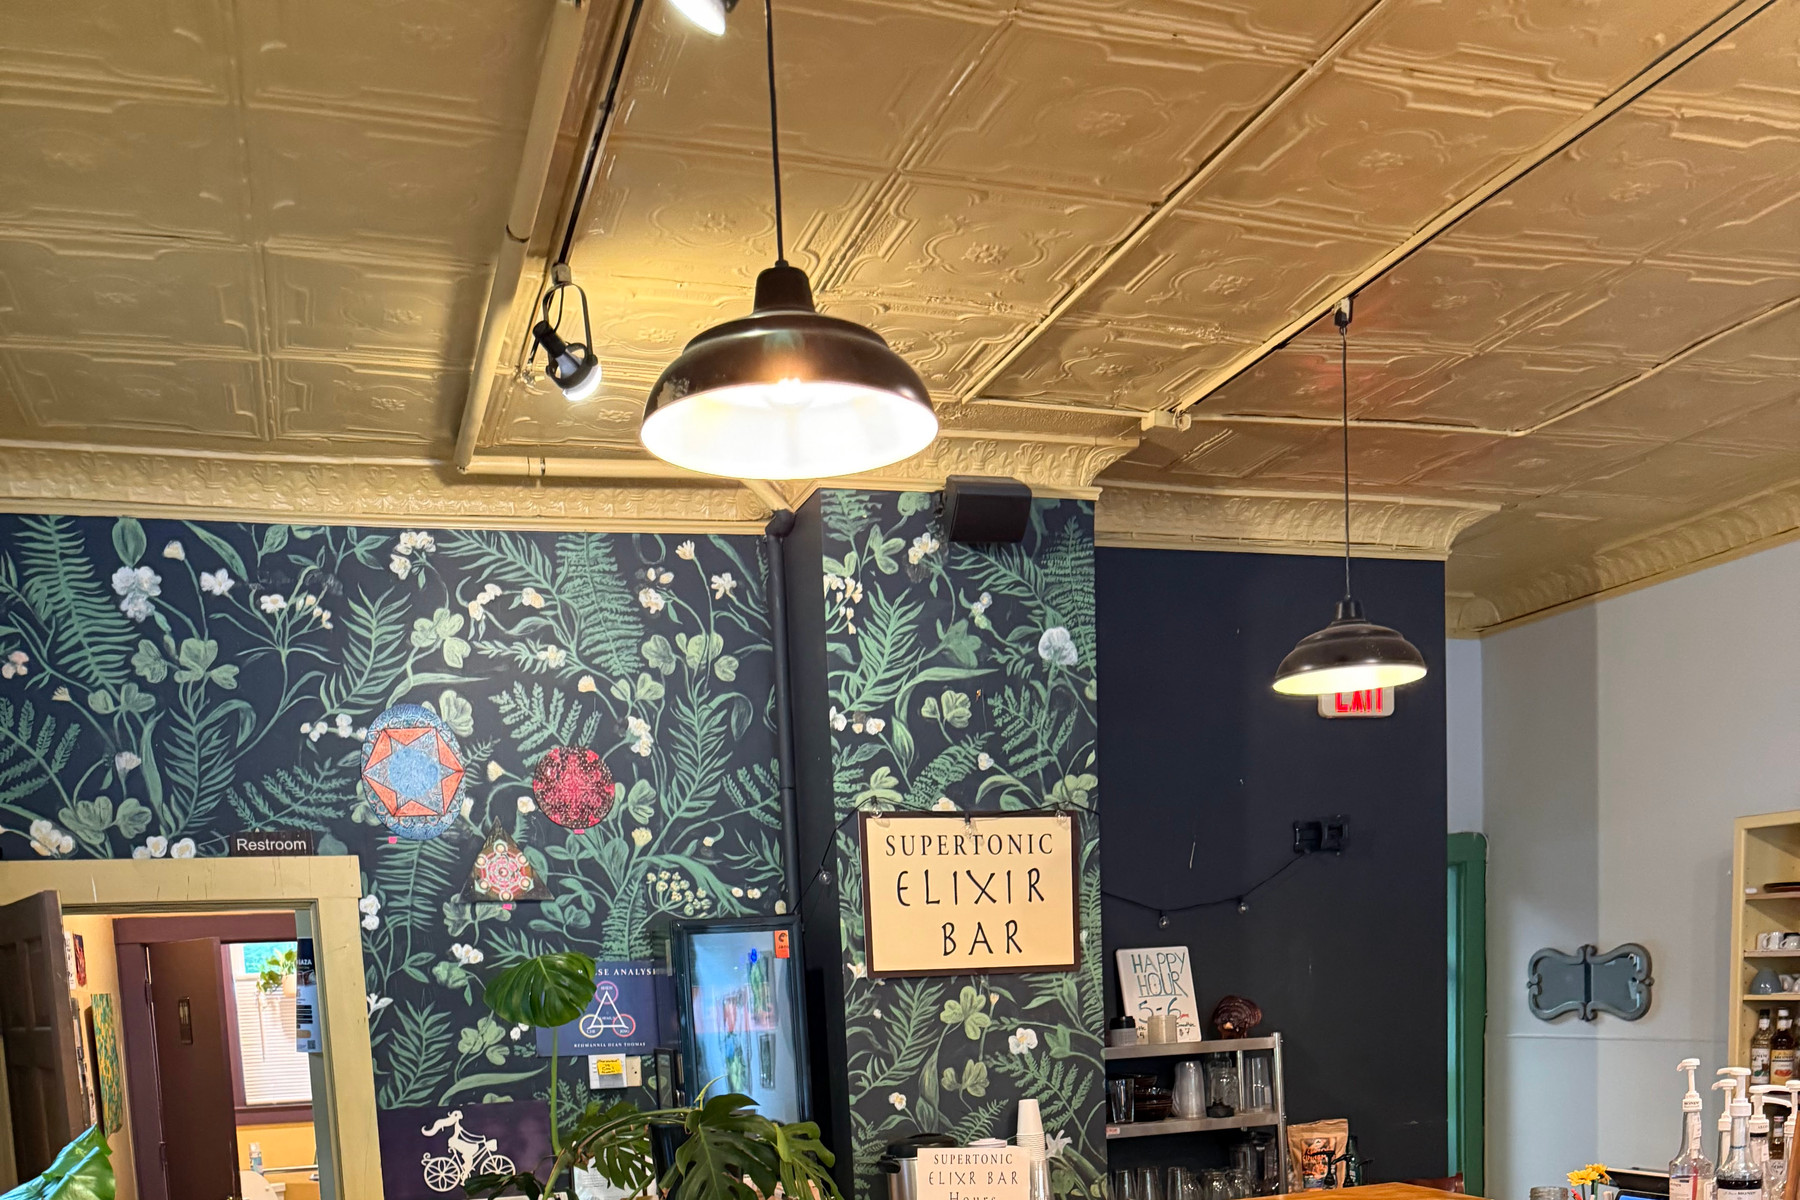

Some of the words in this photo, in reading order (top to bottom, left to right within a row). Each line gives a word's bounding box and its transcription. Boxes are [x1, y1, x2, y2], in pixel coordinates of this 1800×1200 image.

[236, 838, 307, 851] Restroom
[886, 834, 1053, 856] SUPERTONIC
[897, 867, 1045, 907] ELIXIR
[941, 919, 1023, 956] BAR
[1131, 952, 1185, 974] HAPPY
[1137, 971, 1188, 997] HOUR
[934, 1153, 1013, 1165] SUPERTONIC
[929, 1171, 976, 1185] ELIXR
[987, 1171, 1019, 1185] BAR
